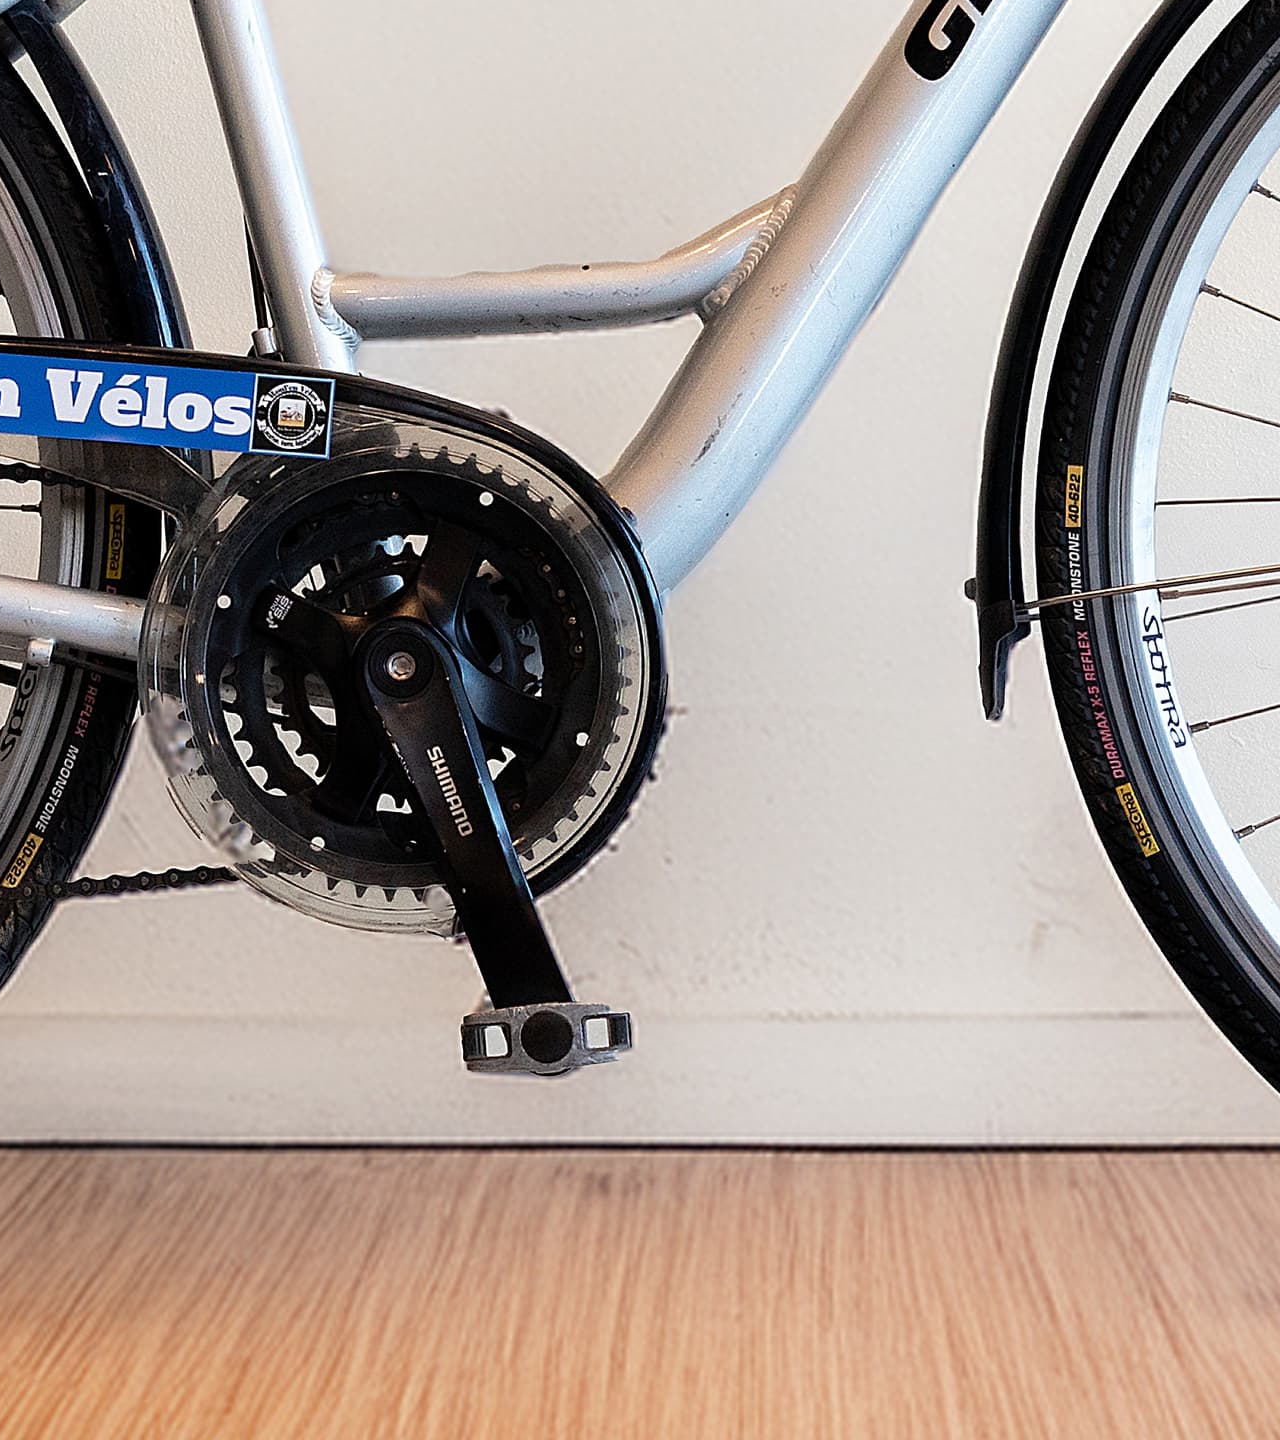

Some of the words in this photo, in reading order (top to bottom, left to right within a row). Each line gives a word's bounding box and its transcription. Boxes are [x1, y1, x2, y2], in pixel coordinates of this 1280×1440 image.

[47, 368, 251, 436] Vélos
[1068, 473, 1081, 524] 40-622
[273, 595, 290, 619] SIS
[1077, 631, 1097, 681] REFLEX
[74, 685, 98, 737] REFLEX
[1087, 686, 1102, 708] X-5
[1095, 712, 1125, 779] DURAMAX
[35, 745, 79, 833] MOONSTONE
[427, 746, 473, 837] SHIMANO
[6, 838, 36, 886] 40-622
